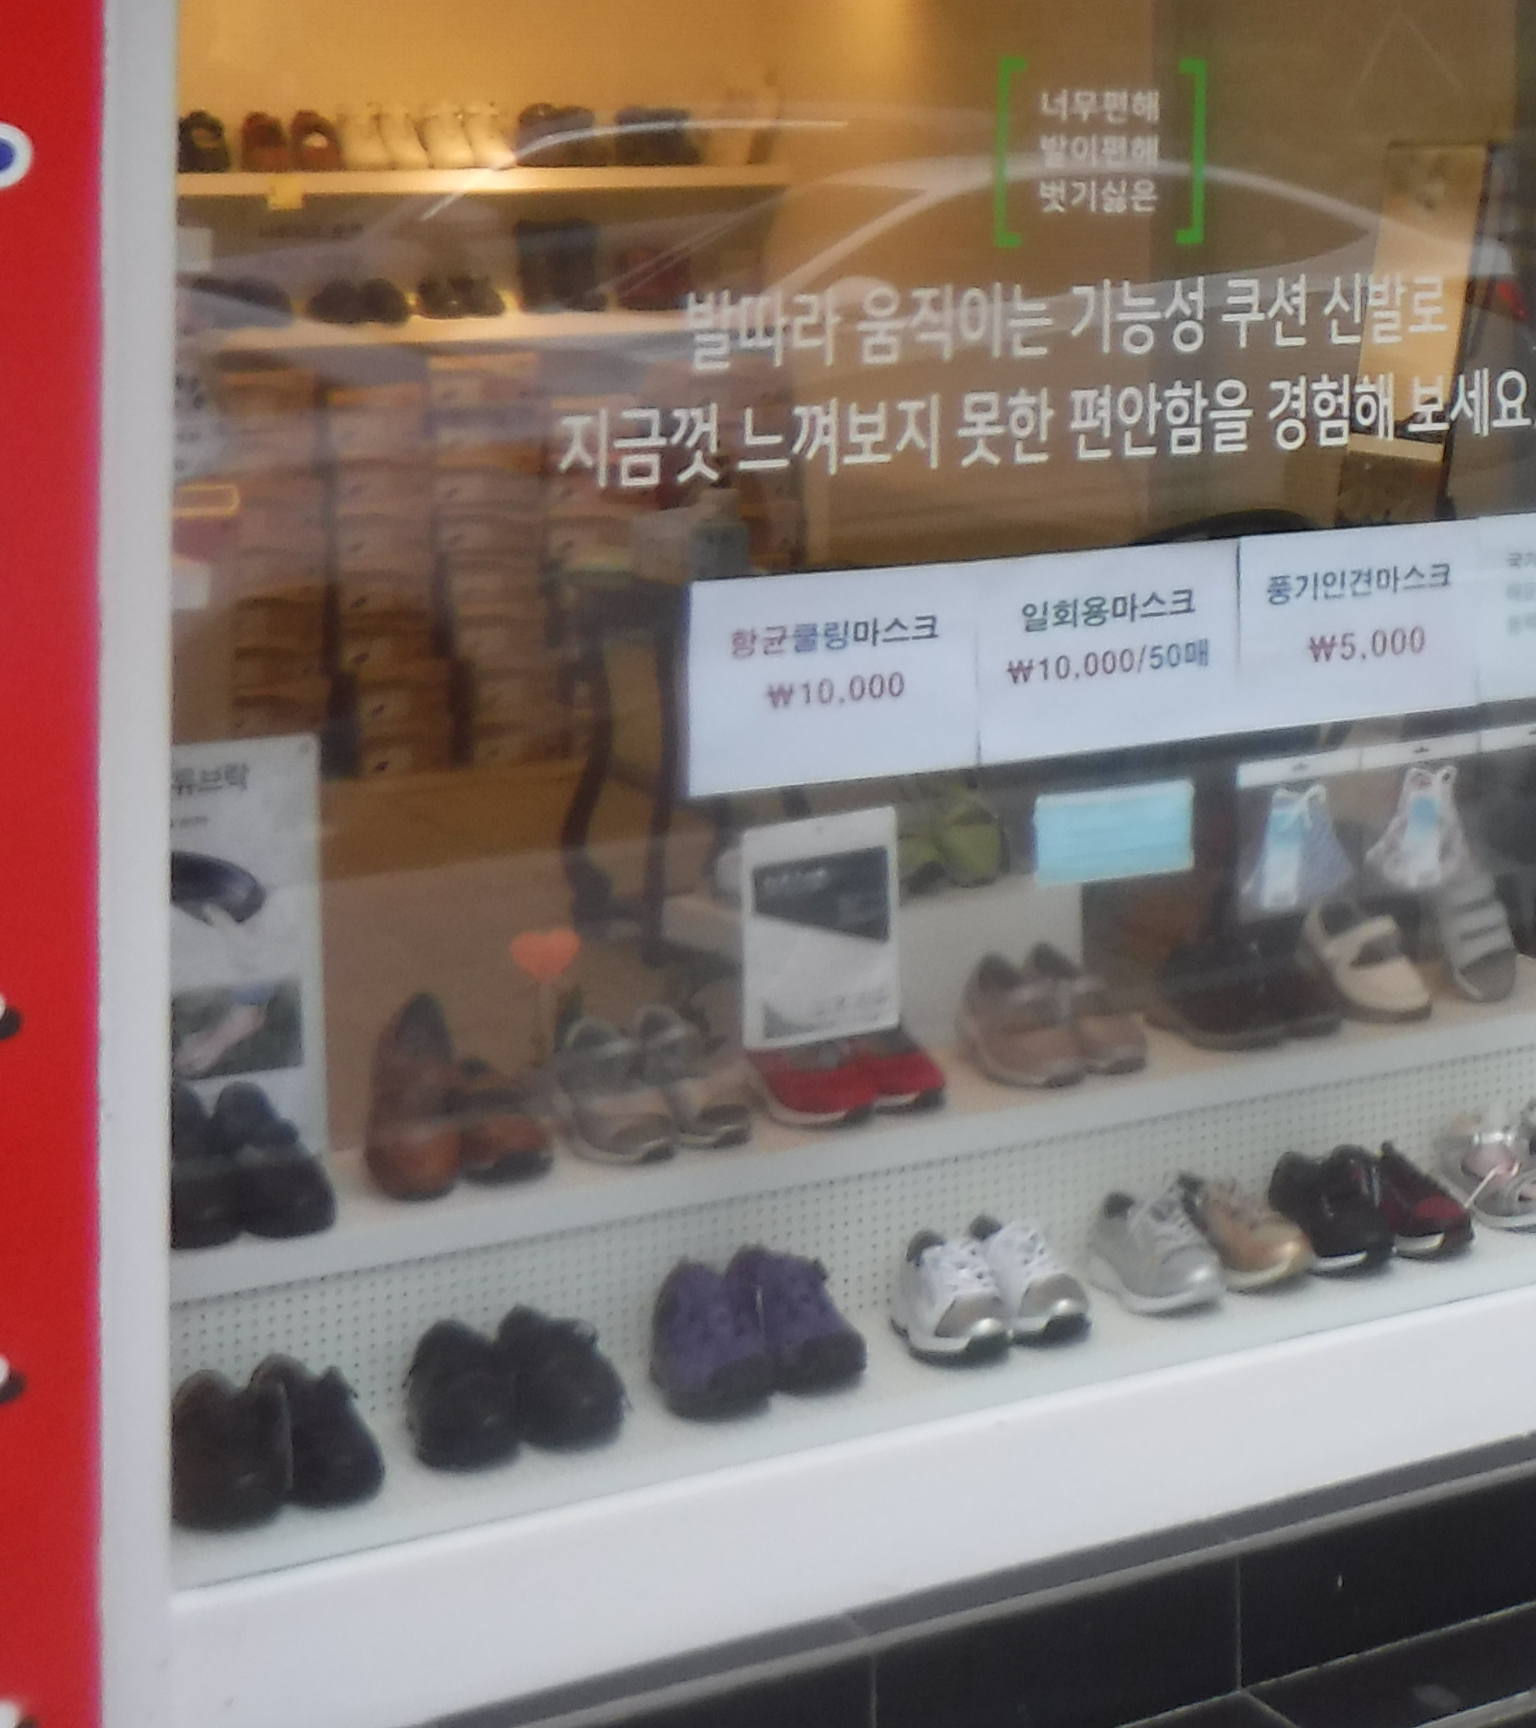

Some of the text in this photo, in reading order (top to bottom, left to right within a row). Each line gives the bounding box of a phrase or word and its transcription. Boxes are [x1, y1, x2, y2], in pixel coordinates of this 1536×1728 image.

[683, 272, 1449, 372] 발따라 움직이는 기능성 쿠션 신발로
[558, 401, 720, 488] 지금껏
[736, 392, 940, 475] 느껴보지
[957, 387, 1055, 468] 못한
[1069, 378, 1253, 462] 편안함을
[1268, 372, 1395, 451] 경험해
[1021, 588, 1196, 633] 일회용마스크
